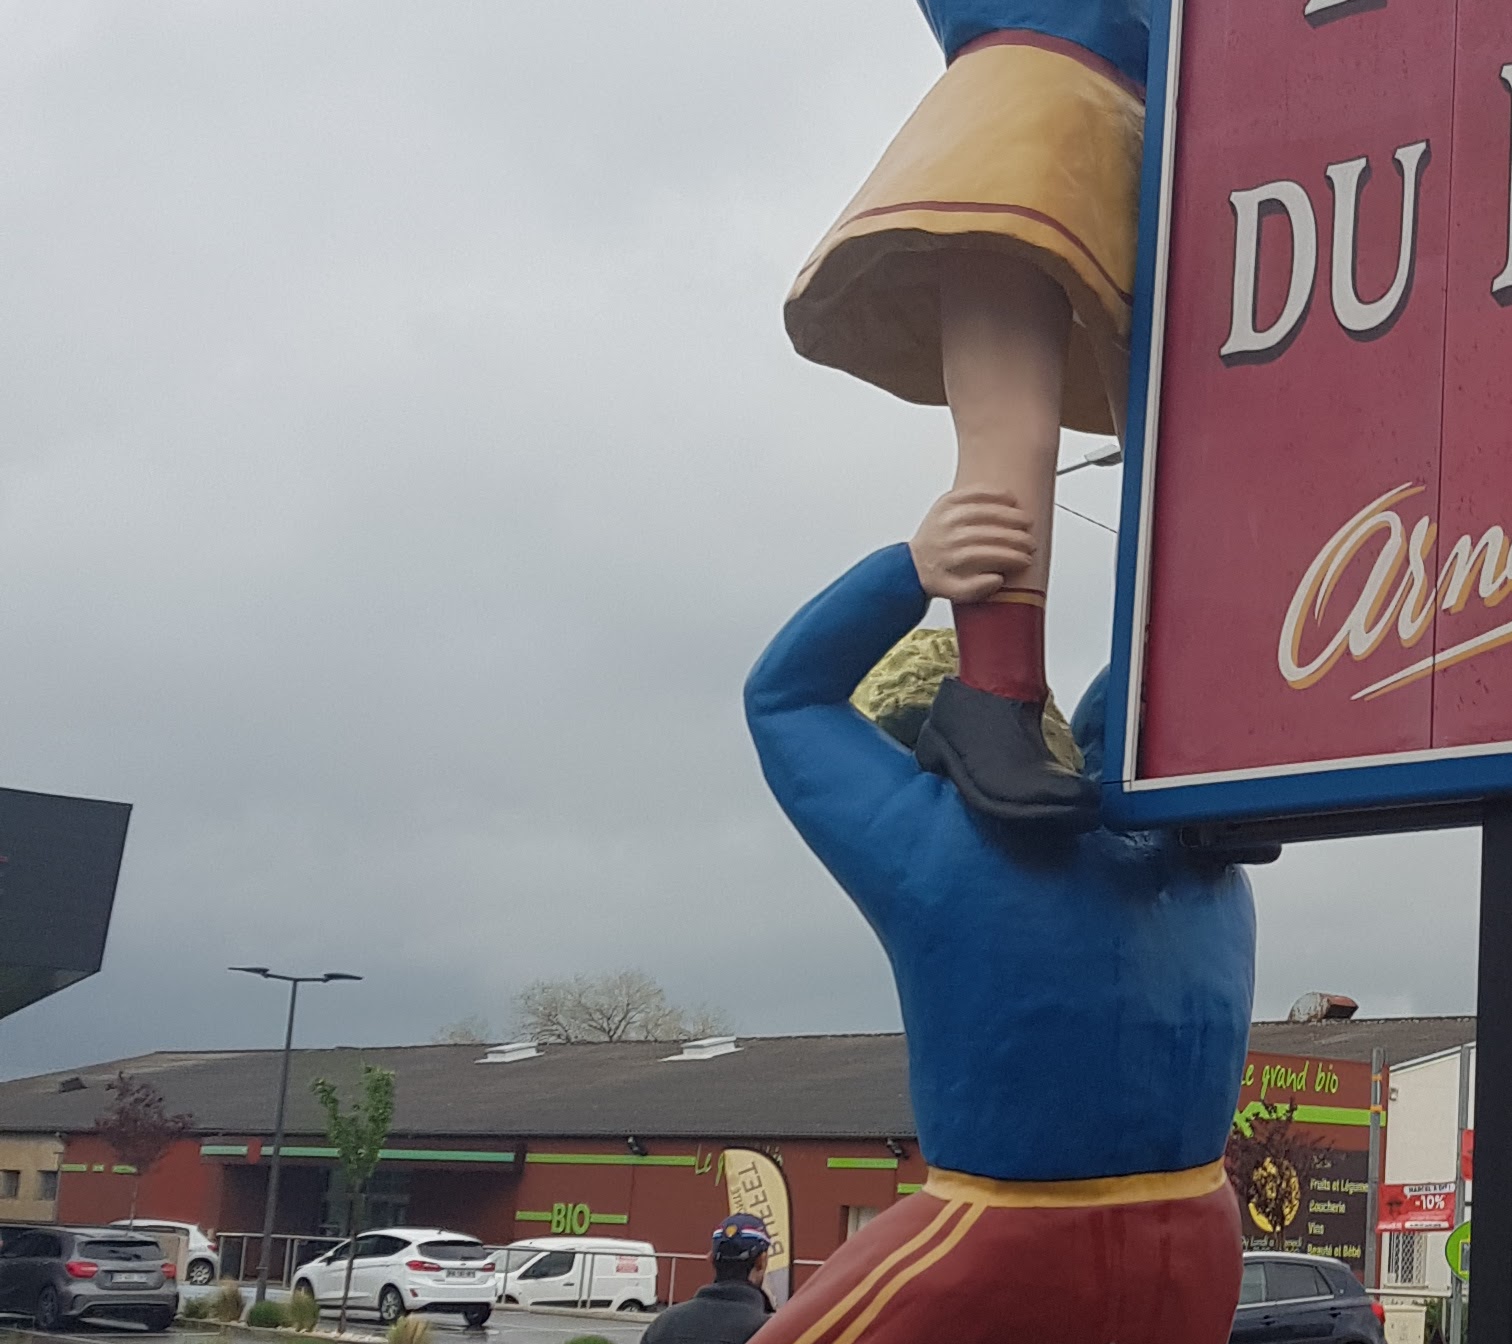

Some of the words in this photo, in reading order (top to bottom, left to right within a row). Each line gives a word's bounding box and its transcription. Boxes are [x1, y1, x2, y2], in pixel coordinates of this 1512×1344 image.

[1219, 139, 1432, 367] DU
[1260, 1060, 1309, 1100] grand
[1315, 1062, 1339, 1093] bio
[551, 1203, 590, 1235] BIO
[1415, 1195, 1446, 1210] -10%
